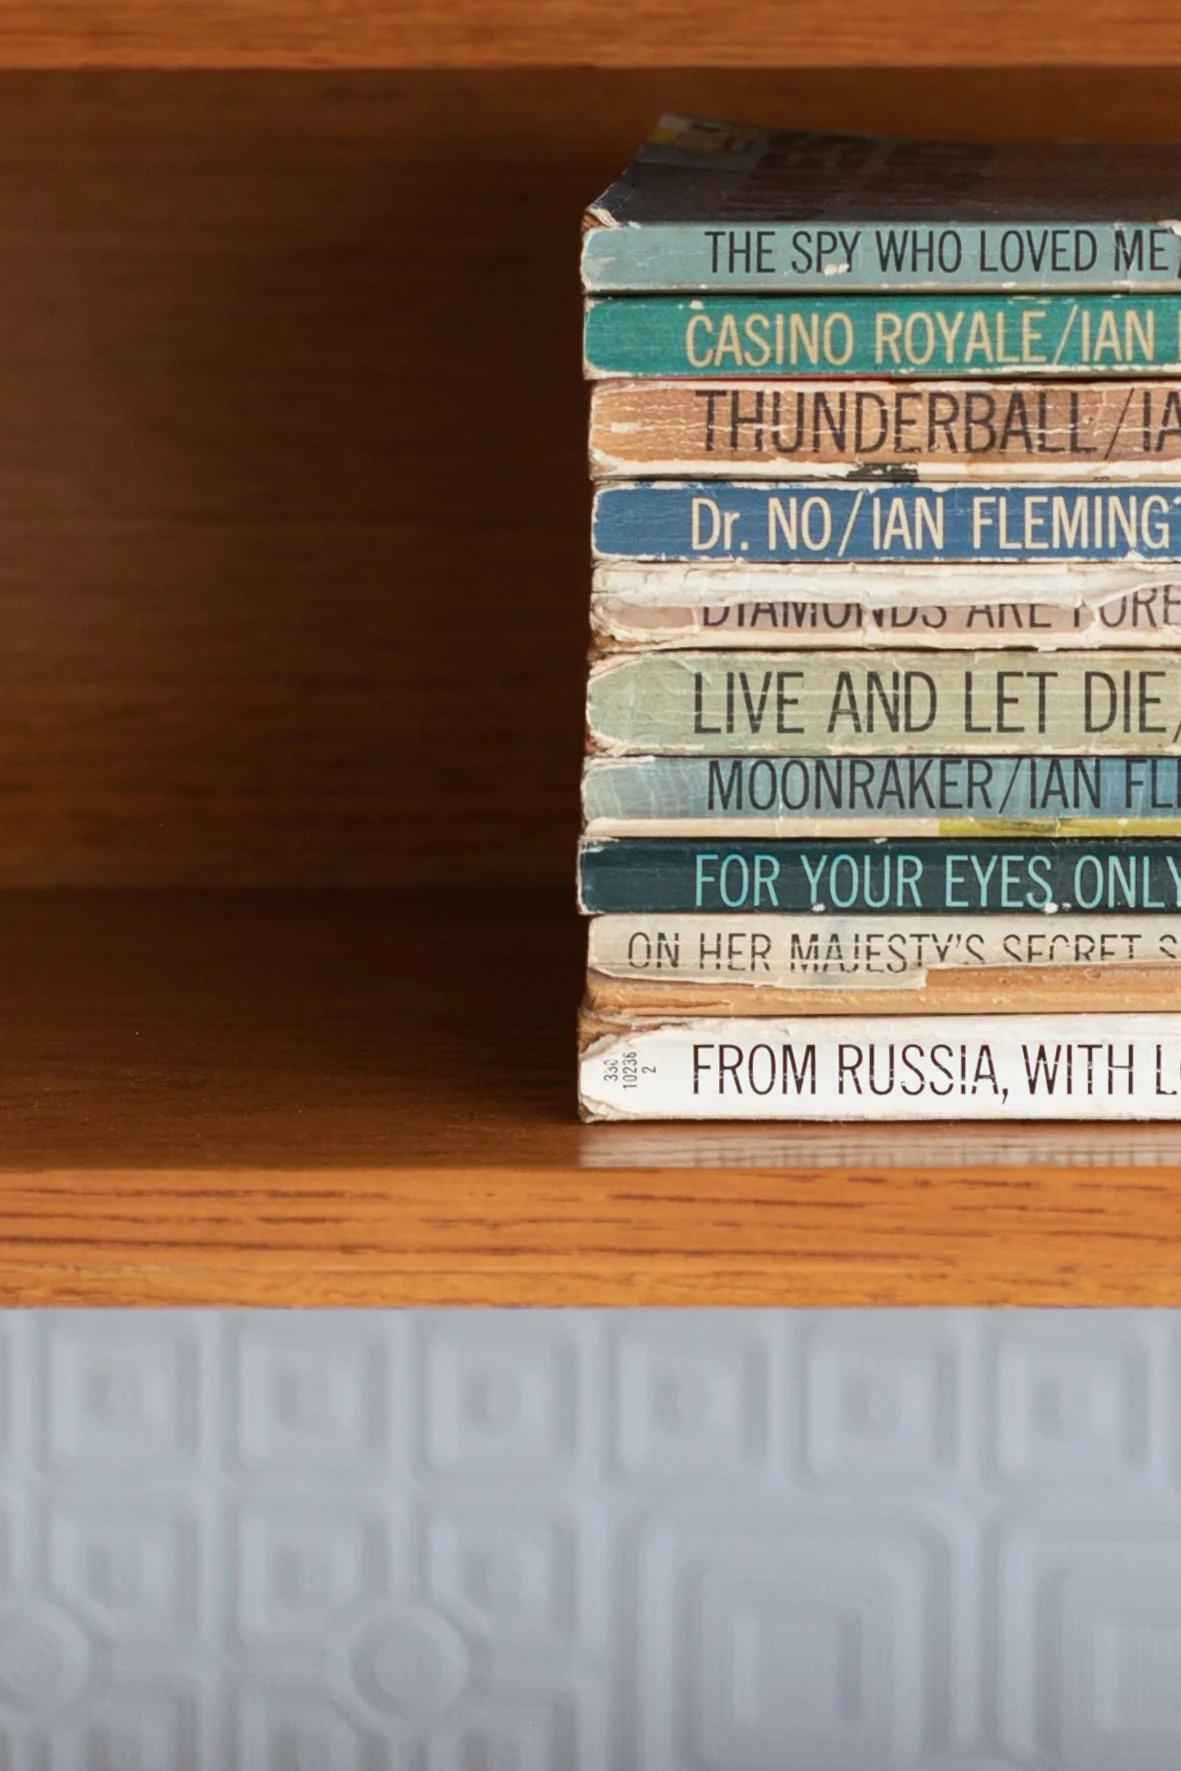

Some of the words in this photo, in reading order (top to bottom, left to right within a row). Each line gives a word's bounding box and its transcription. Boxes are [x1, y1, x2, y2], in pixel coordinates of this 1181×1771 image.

[704, 230, 776, 274] THE
[791, 229, 862, 274] SPY
[875, 229, 963, 273] WHO
[979, 229, 1098, 273] LOVED
[685, 311, 854, 367] CASINO
[690, 496, 750, 552] Dr.
[972, 494, 1171, 551] FLEMING
[694, 670, 805, 734] LIVE
[827, 670, 938, 734] AND
[964, 670, 1058, 733] LET
[694, 854, 781, 908] FOR
[800, 853, 923, 908] YOUR
[945, 854, 1054, 909] EYES
[627, 931, 680, 969] ON
[699, 932, 771, 972] HER
[789, 932, 985, 974] MAJESTY'S
[641, 1065, 657, 1074] 2
[691, 1044, 817, 1096] FROM
[837, 1043, 1010, 1105] RUSSIA,
[1021, 1043, 1134, 1095] WITH
